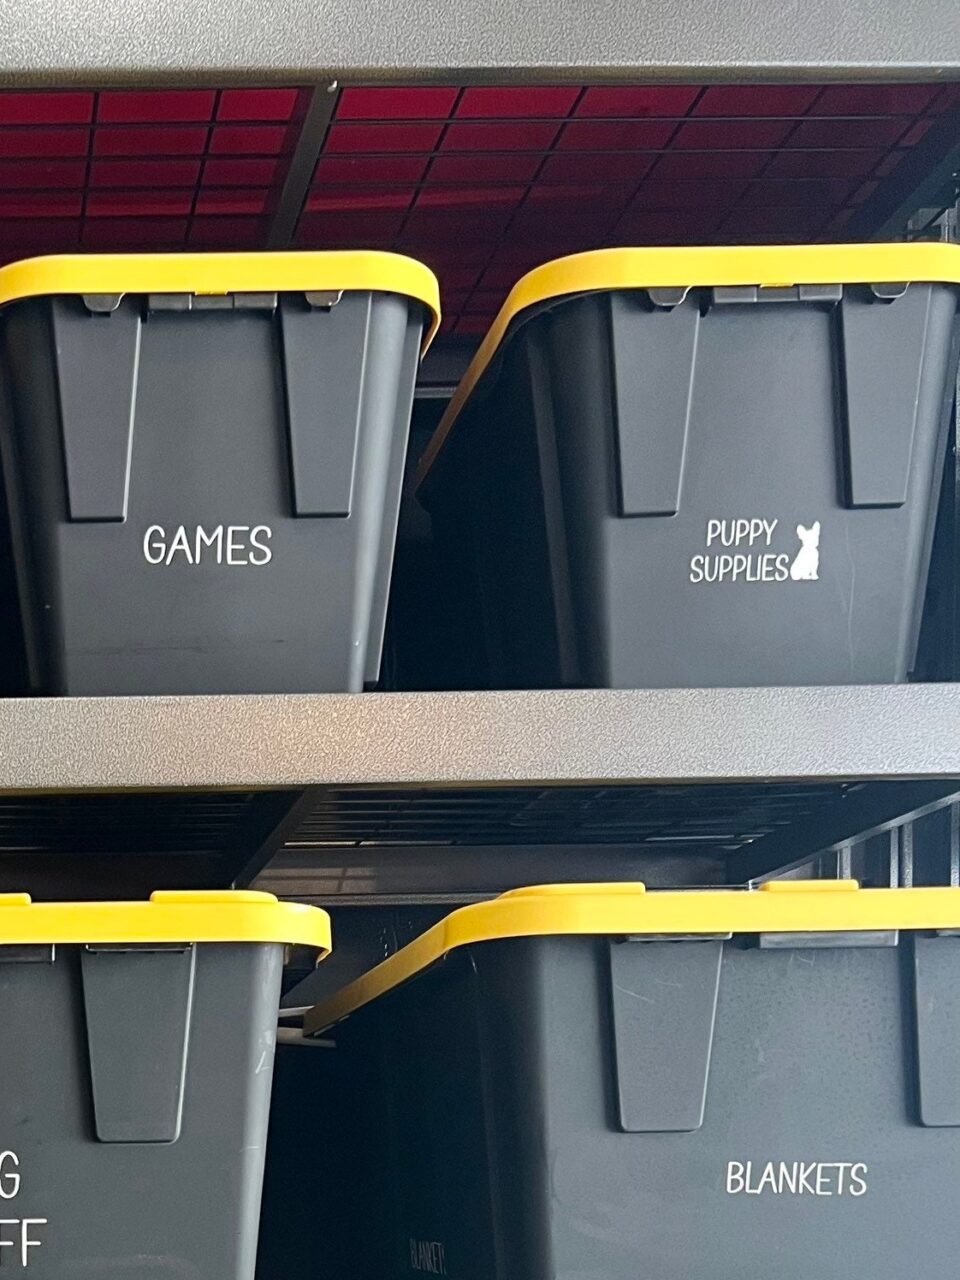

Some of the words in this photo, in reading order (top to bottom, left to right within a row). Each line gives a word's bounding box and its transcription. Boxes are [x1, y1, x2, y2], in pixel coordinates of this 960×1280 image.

[143, 524, 272, 566] GAMES
[706, 518, 778, 547] PUPPY
[689, 554, 790, 583] SUPPLIES
[726, 1160, 868, 1197] BLANKETS
